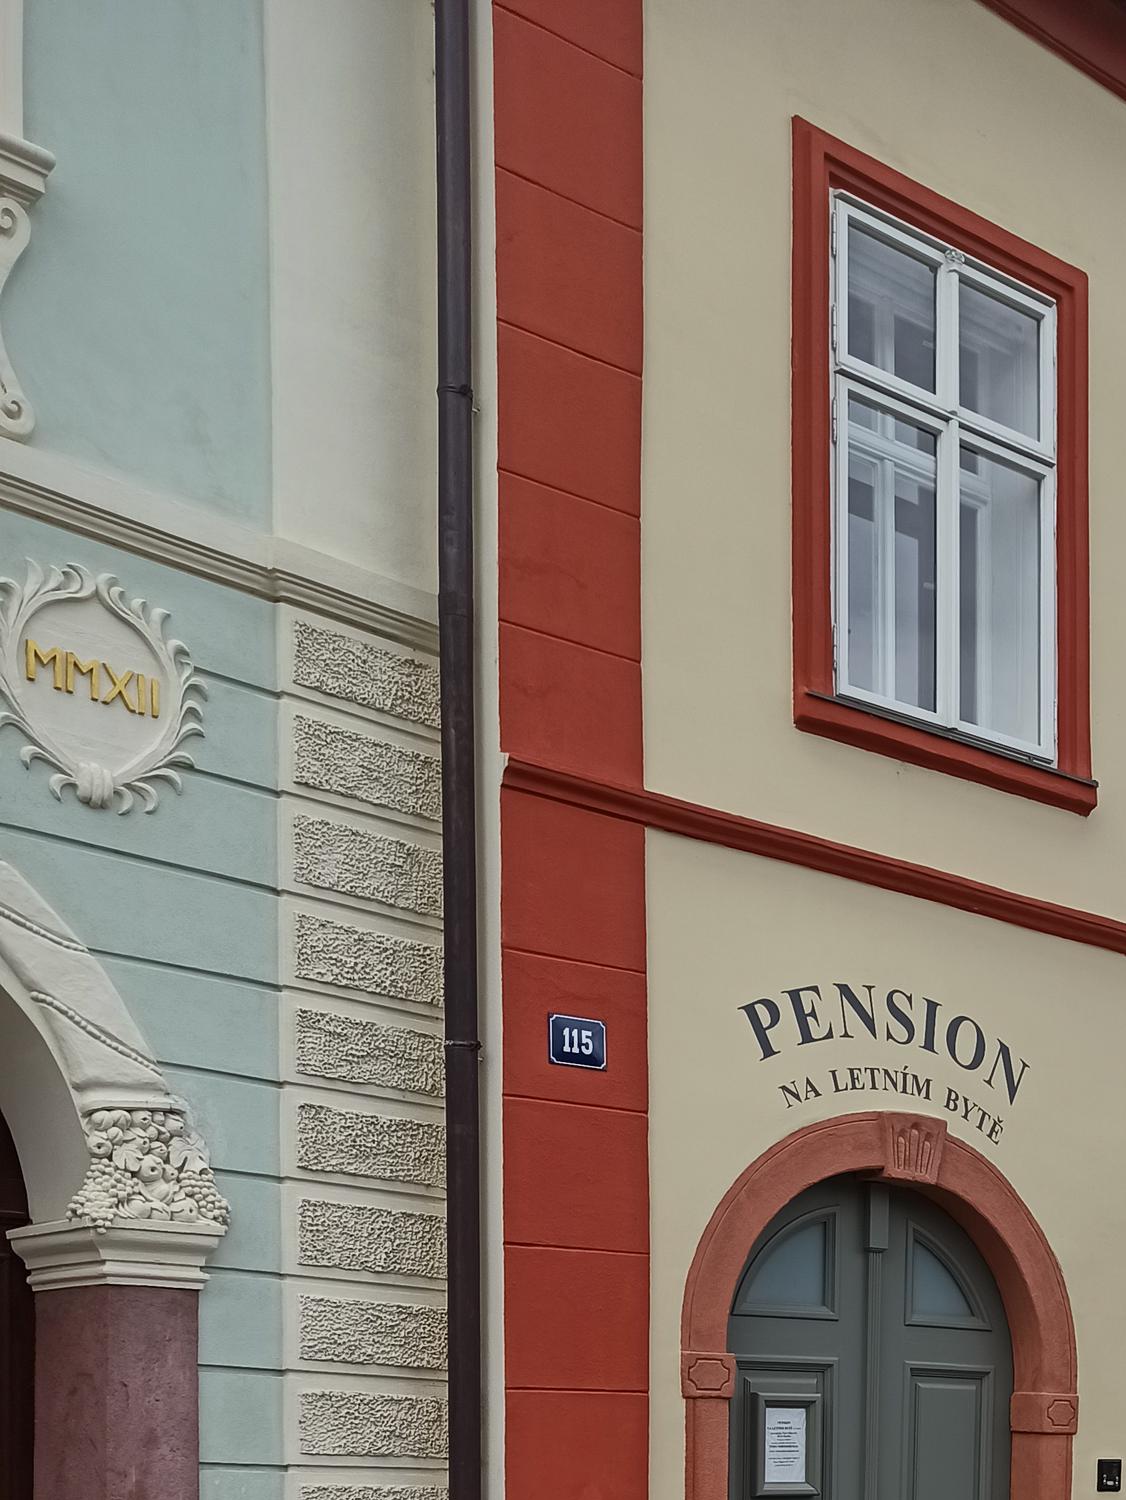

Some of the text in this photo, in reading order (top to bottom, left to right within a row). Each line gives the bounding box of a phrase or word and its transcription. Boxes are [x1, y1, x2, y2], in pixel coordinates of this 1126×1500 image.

[25, 639, 161, 719] MMXII
[562, 1027, 594, 1055] 115
[737, 983, 1031, 1106] PENSION
[777, 1064, 1005, 1146] NA LETNÍM BYTĚ
